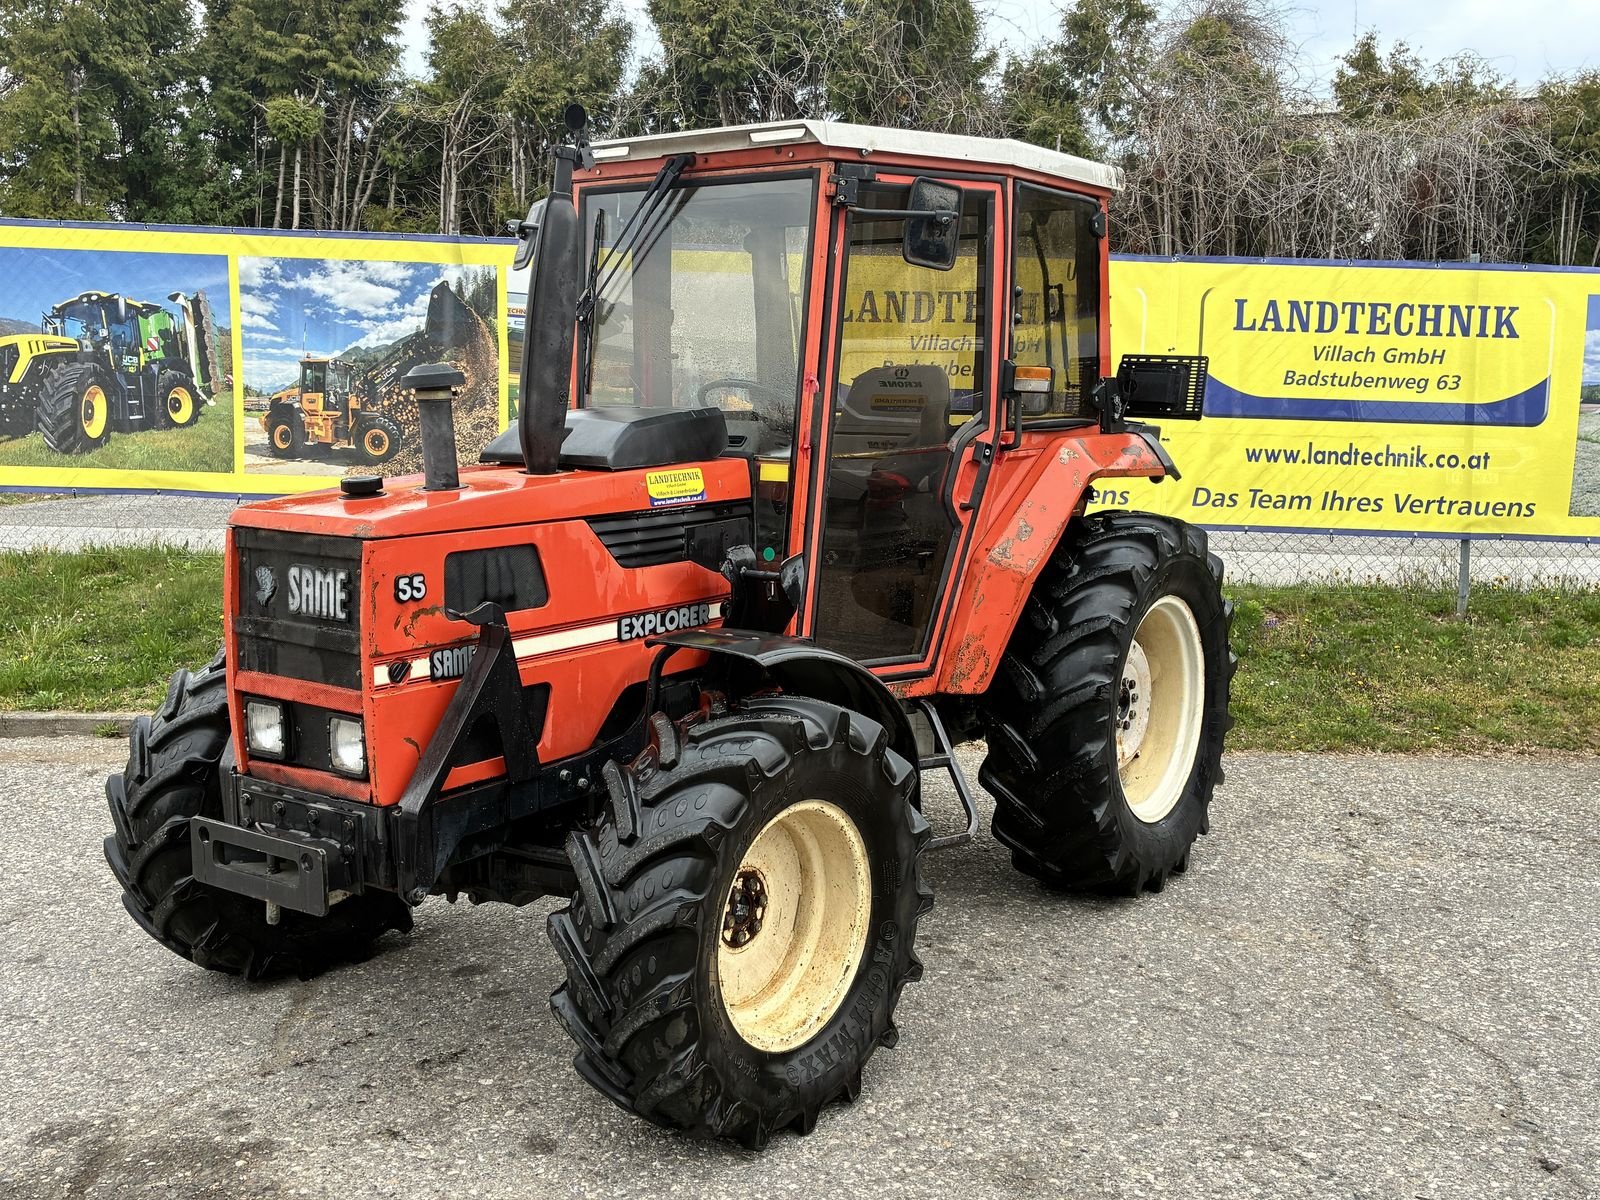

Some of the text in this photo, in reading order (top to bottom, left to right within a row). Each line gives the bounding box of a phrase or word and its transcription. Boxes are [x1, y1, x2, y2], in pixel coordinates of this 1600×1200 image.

[1233, 298, 1520, 339] LANDTECHNIK
[910, 334, 972, 352] Villach
[1312, 345, 1446, 365] Villach GmbH
[1283, 370, 1462, 393] Badstubenweg 63
[1245, 441, 1491, 470] www.landtechnik.co.at
[648, 471, 701, 485] LANDTECHNIK
[1191, 486, 1536, 518] Das Team Ihres Vertrauens
[287, 565, 348, 620] SAME
[397, 574, 427, 602] 55
[620, 603, 710, 641] EXPLORER
